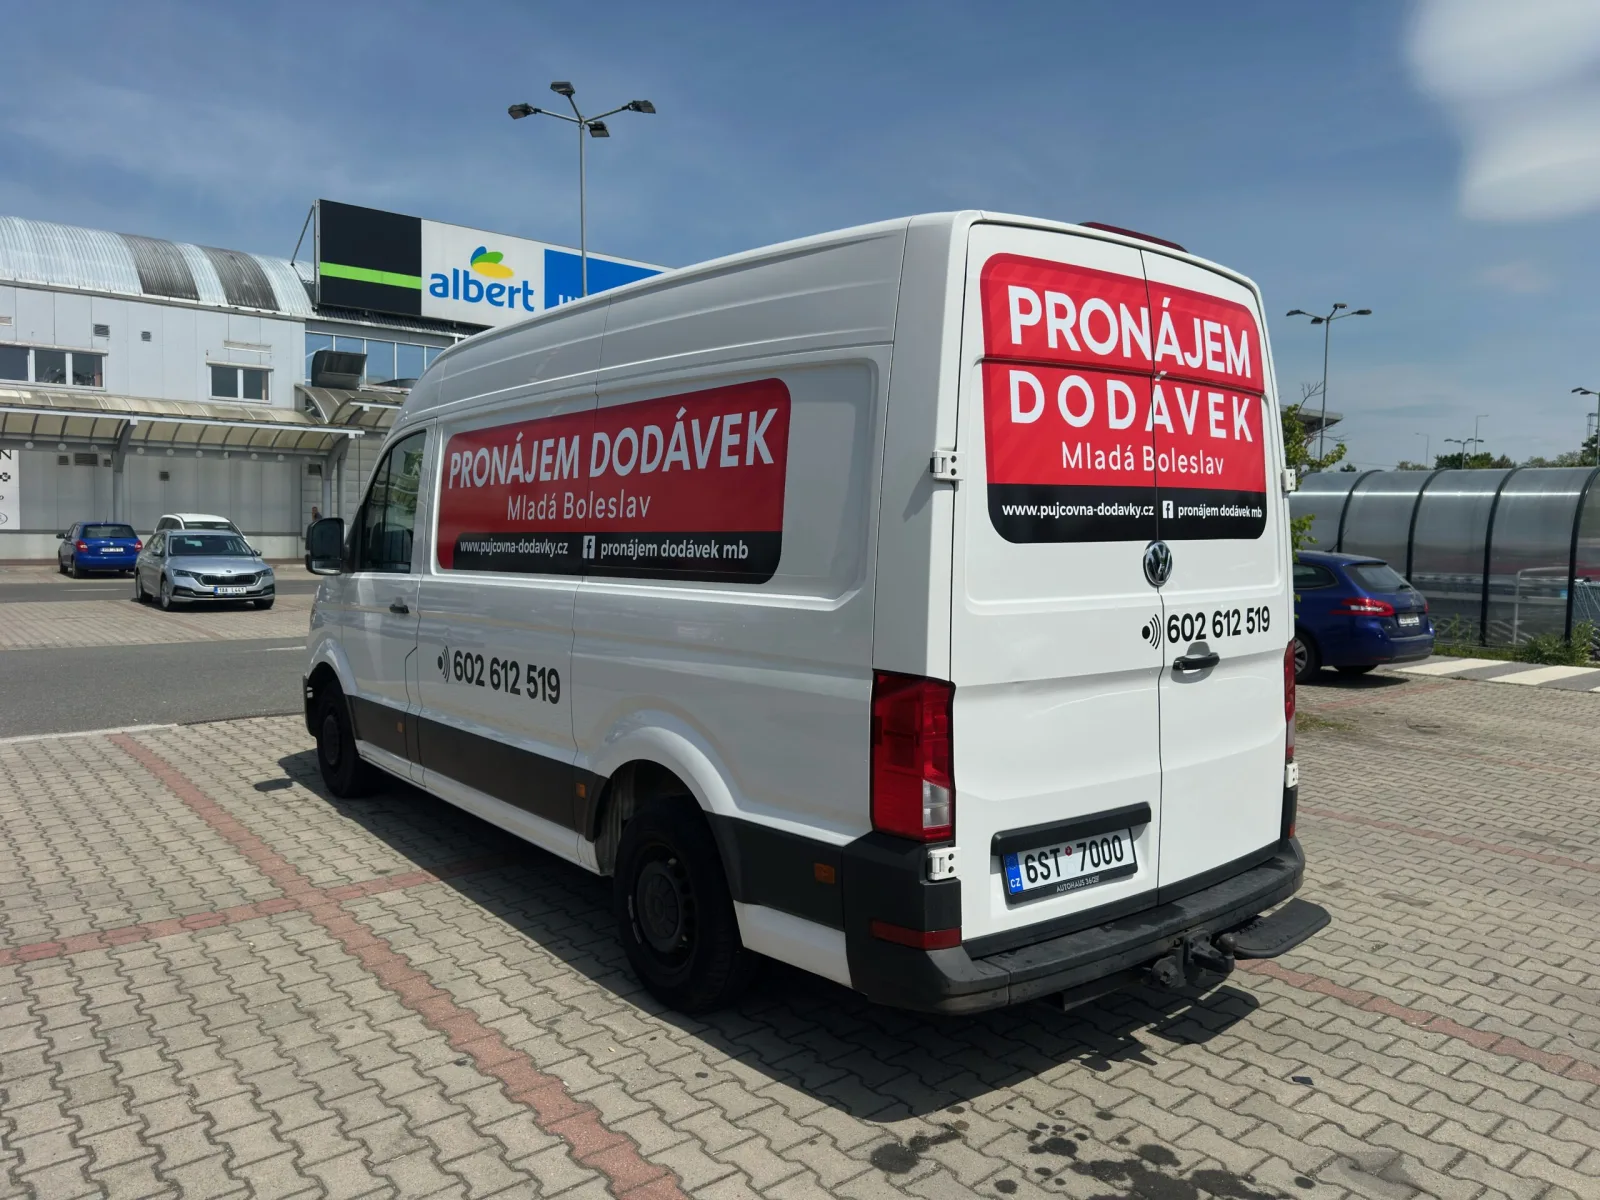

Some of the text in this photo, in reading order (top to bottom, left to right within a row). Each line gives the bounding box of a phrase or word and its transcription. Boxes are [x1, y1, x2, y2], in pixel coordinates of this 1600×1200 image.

[429, 268, 534, 312] albert
[1008, 285, 1252, 379] PRONÁJEM
[1008, 370, 1253, 442] DODÁVEK
[449, 406, 778, 489] PRONÁJEM DODÁVEK
[1061, 441, 1224, 475] Mladá Boleslav
[507, 489, 651, 521] Mladá Boleslav
[1002, 502, 1155, 518] www.pujcovna-dodavky.cz
[1178, 504, 1218, 519] pronájem
[1219, 504, 1250, 518] dodávek
[1251, 506, 1263, 518] mb
[460, 538, 568, 557] www.pujcovna-dodavky.cz
[600, 539, 658, 560] pronájem
[660, 539, 720, 559] dodávek
[723, 539, 749, 559] mb
[1167, 606, 1270, 643] 602 612 519
[454, 650, 560, 704] 602 612 519
[1024, 835, 1124, 883] 6ST 7000
[1010, 877, 1021, 888] CZ
[1056, 878, 1085, 892] AUTOHAUS
